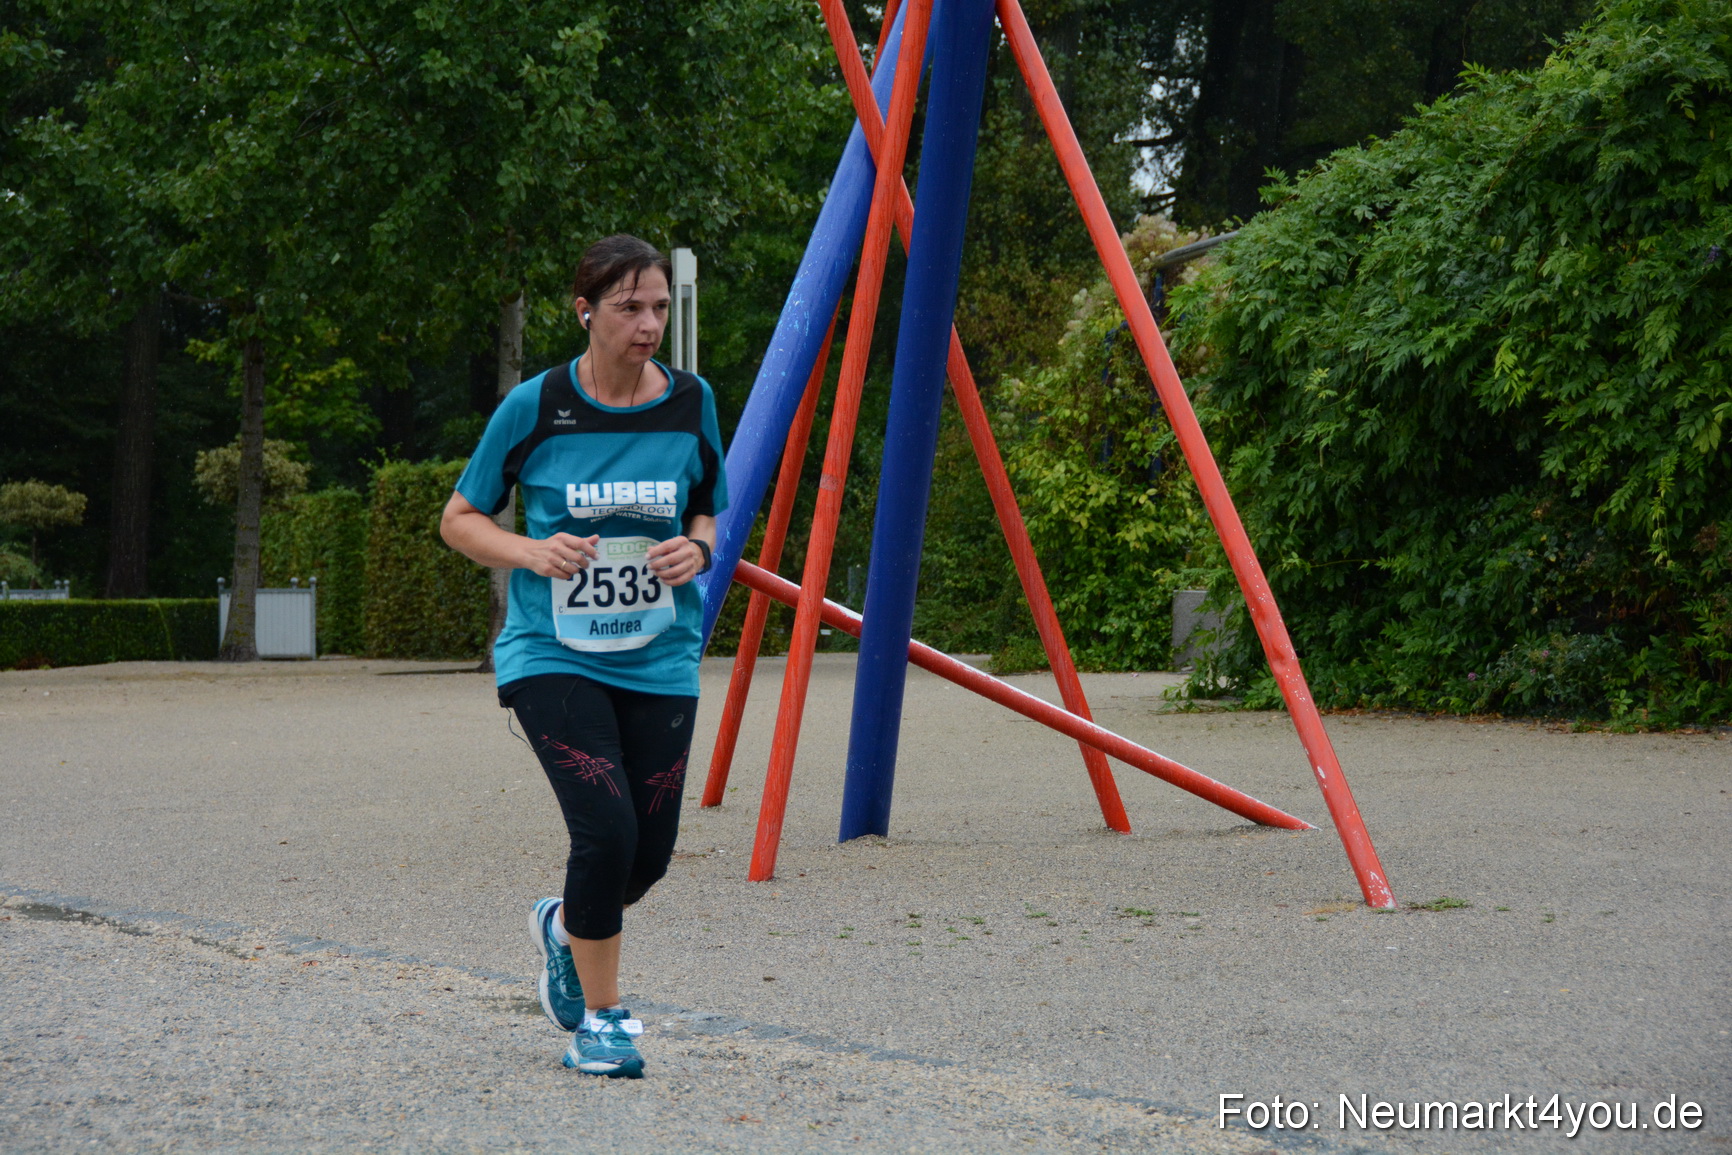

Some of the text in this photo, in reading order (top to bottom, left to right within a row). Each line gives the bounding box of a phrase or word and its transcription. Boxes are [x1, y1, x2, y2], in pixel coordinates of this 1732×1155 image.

[566, 481, 678, 507] HUBER
[615, 511, 641, 519] WATER
[567, 565, 662, 608] 2533
[589, 618, 642, 635] Andrea
